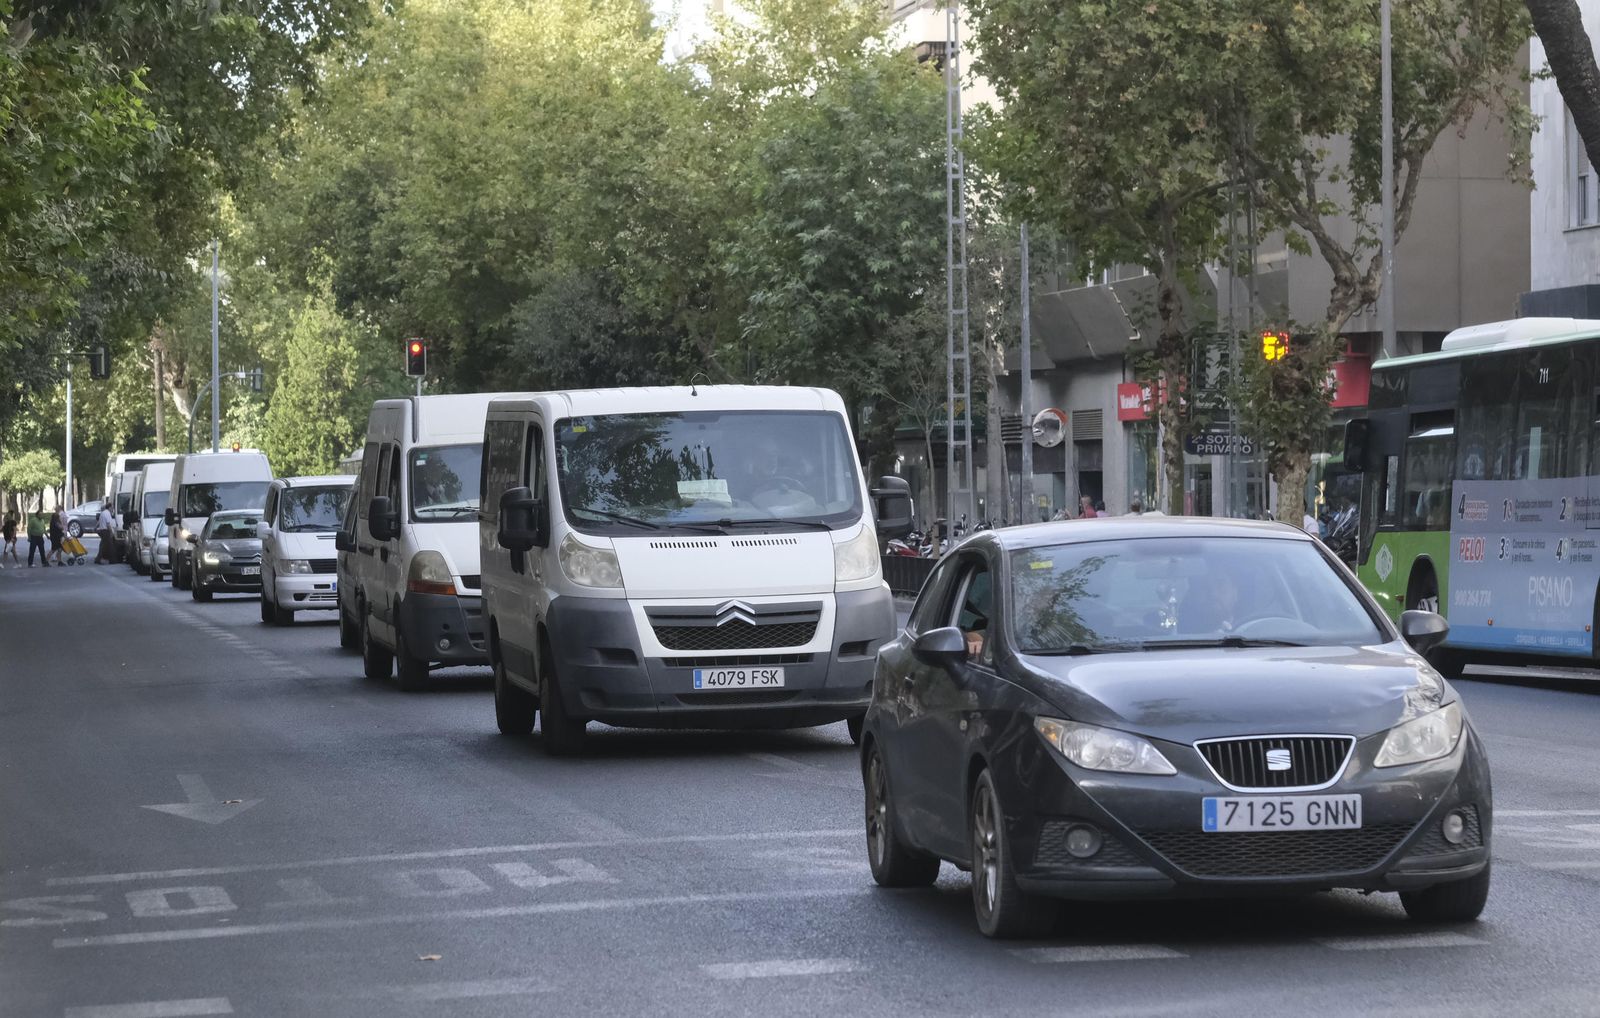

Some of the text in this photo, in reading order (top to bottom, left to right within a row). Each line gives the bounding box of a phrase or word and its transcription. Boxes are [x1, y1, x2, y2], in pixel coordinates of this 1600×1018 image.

[1532, 367, 1549, 384] 711
[1458, 538, 1485, 561] PELO!
[1528, 576, 1573, 607] PISANO
[708, 671, 746, 686] 4079
[752, 670, 778, 685] FSK
[1224, 801, 1294, 826] 7125
[1307, 799, 1357, 825] GNN
